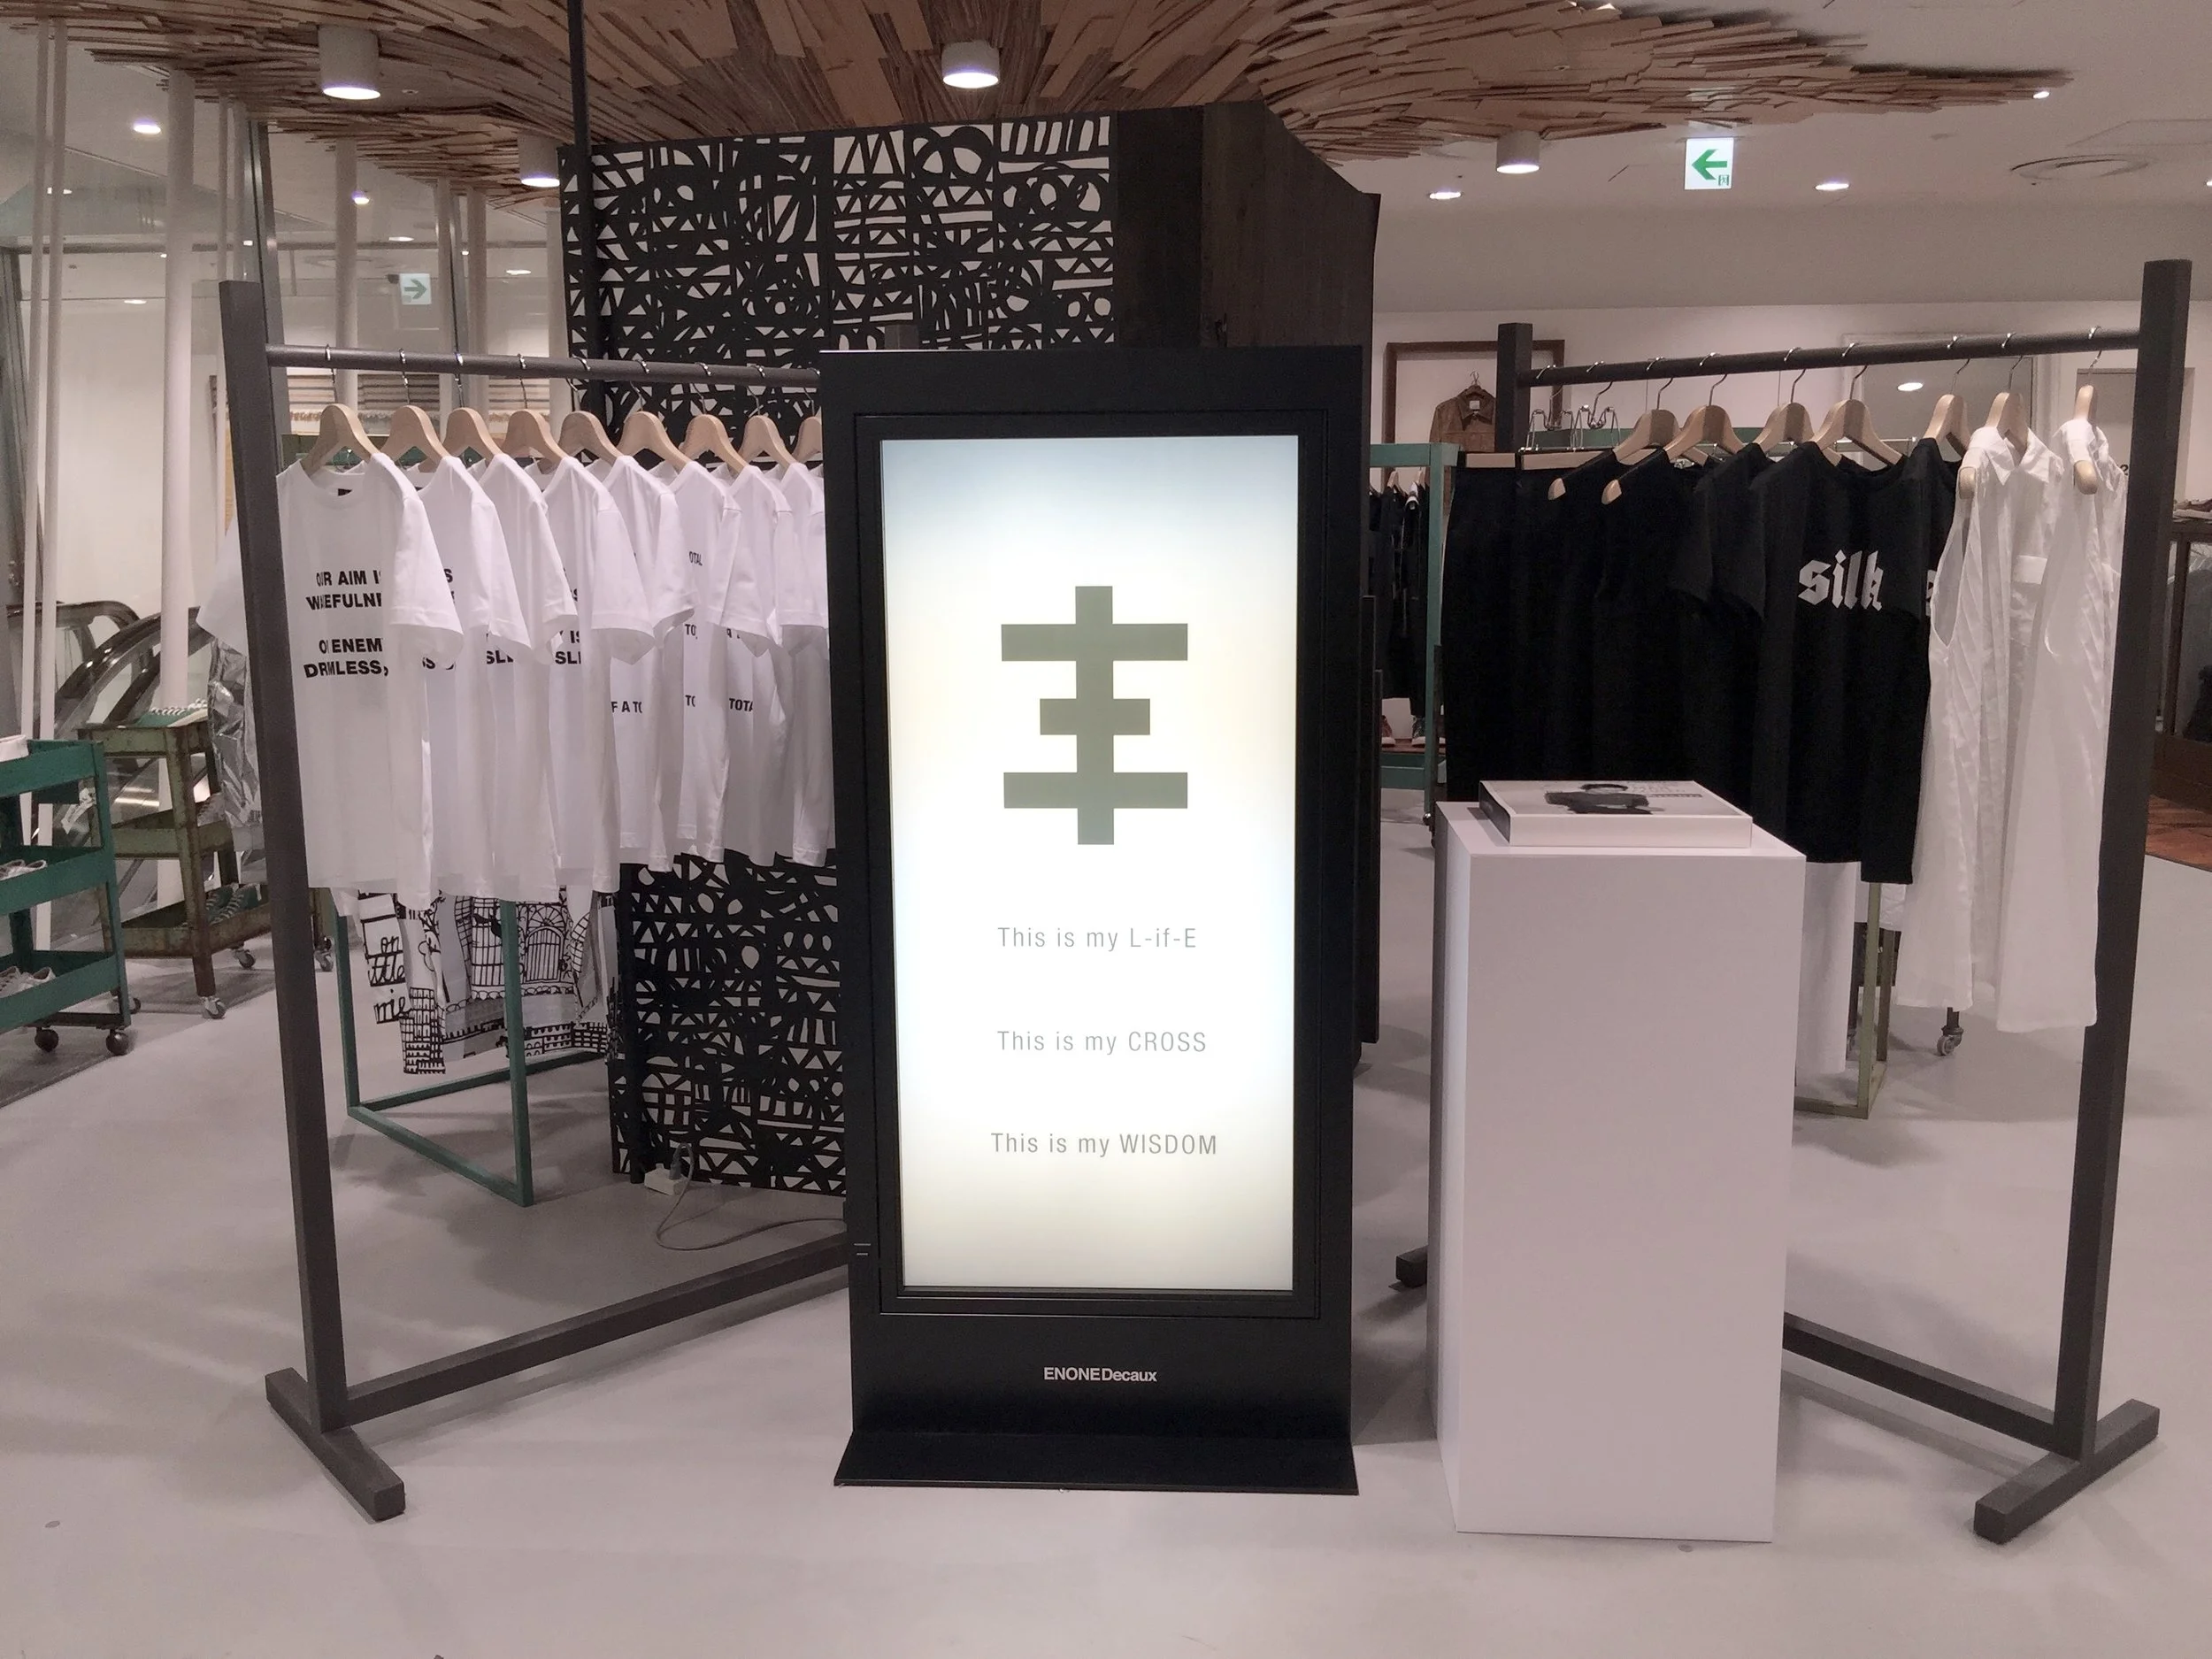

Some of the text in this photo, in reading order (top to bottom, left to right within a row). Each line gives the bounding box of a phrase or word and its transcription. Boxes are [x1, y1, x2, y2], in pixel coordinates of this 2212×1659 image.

[338, 570, 367, 585] AIM
[331, 638, 383, 653] ENEM
[621, 701, 631, 713] A
[997, 926, 1196, 952] This is my L-if-E
[996, 1030, 1206, 1056] This is my CROSS
[990, 1133, 1217, 1158] This is my WISDOM
